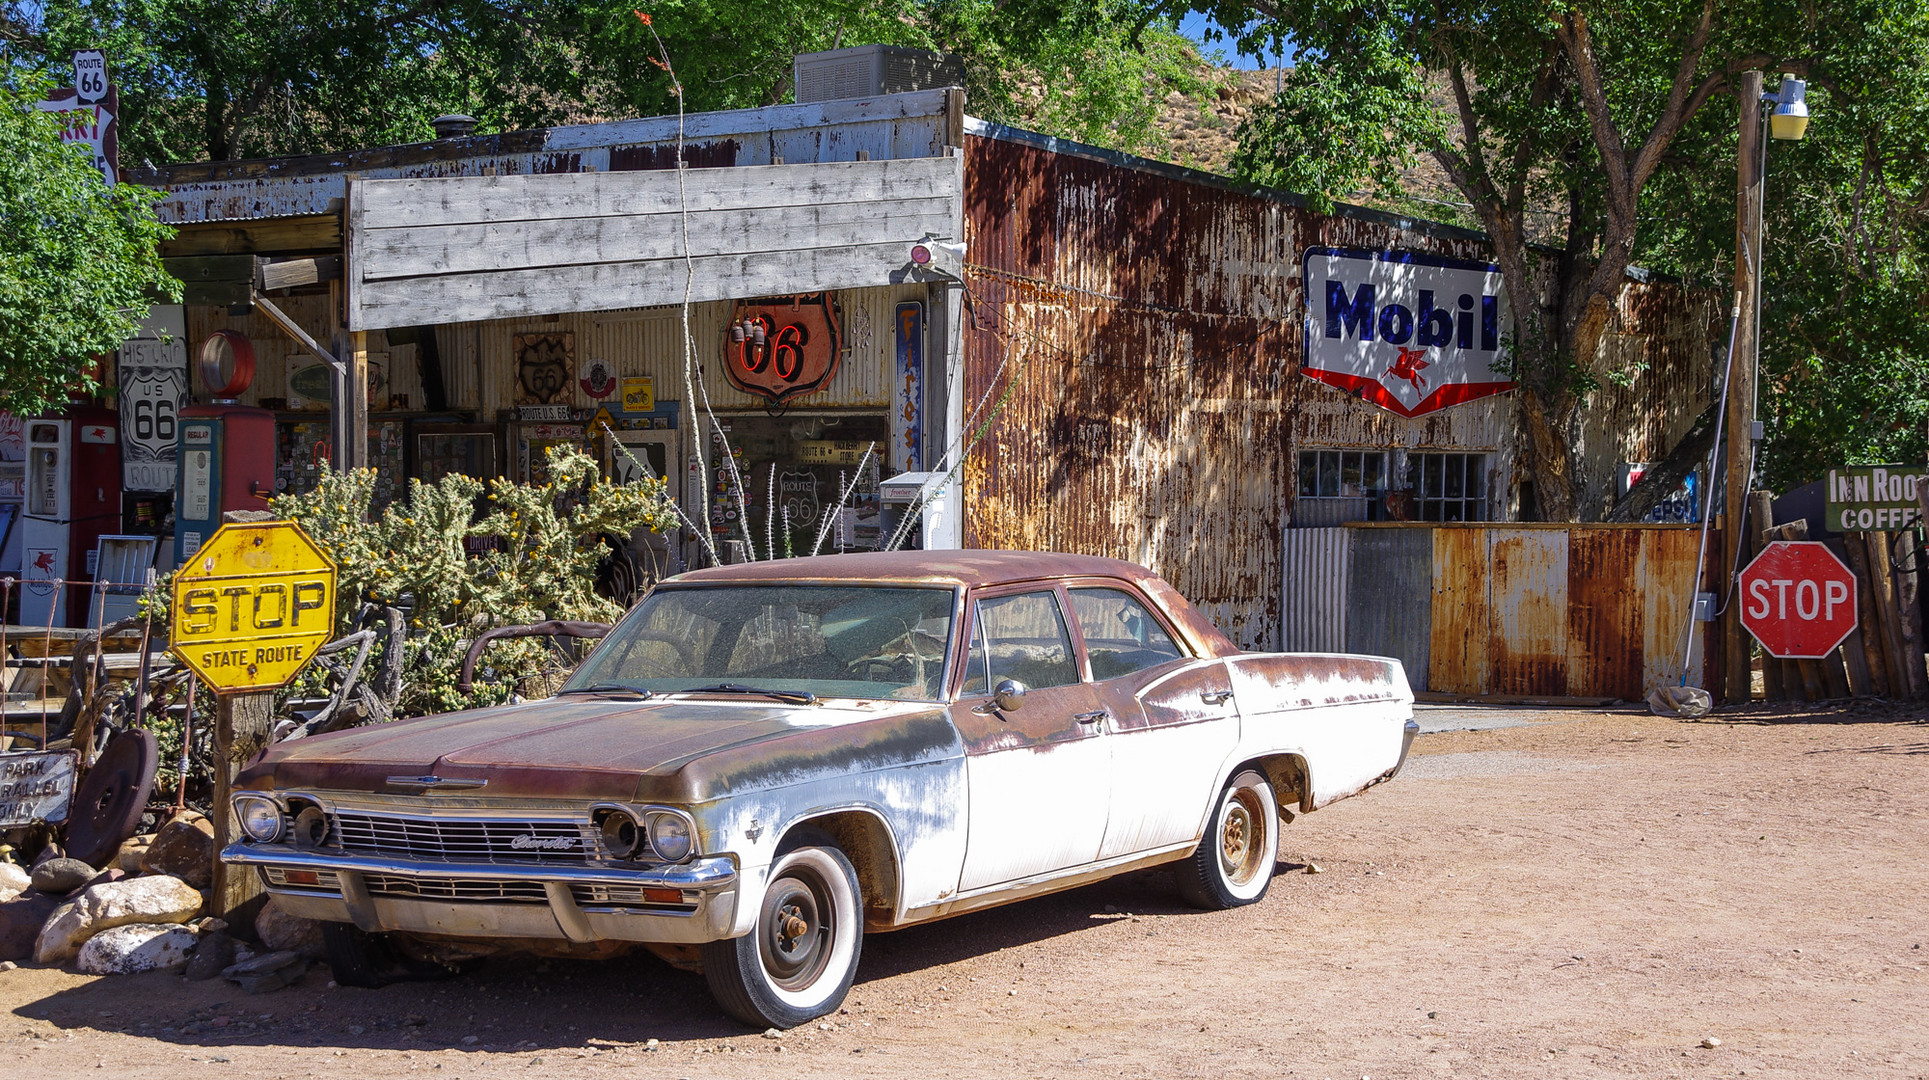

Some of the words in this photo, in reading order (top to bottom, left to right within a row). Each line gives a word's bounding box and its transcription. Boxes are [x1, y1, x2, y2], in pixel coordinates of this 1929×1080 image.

[78, 59, 102, 69] ROUTE
[81, 72, 103, 93] 66
[1325, 279, 1498, 352] Mobil
[740, 313, 809, 383] 66
[143, 384, 164, 397] US
[532, 368, 557, 392] 66
[135, 399, 176, 441] 66
[521, 406, 542, 420] ROUTE
[557, 405, 568, 420] 66
[187, 431, 209, 439] REGULAR
[801, 446, 818, 457] ROUTE
[819, 446, 826, 457] 66
[839, 451, 855, 462] STORE
[783, 481, 813, 492] ROUTE
[1829, 469, 1869, 503] INN
[1872, 468, 1922, 503] ROO
[787, 496, 812, 520] 66
[1645, 499, 1689, 520] EPSI
[469, 535, 494, 550] DRIVE
[181, 579, 327, 635] STOP
[1747, 578, 1849, 621] STOP
[202, 649, 249, 669] STATE
[255, 644, 304, 664] ROUTE
[5, 759, 47, 776] PARK
[511, 833, 577, 850] Chevrolet
